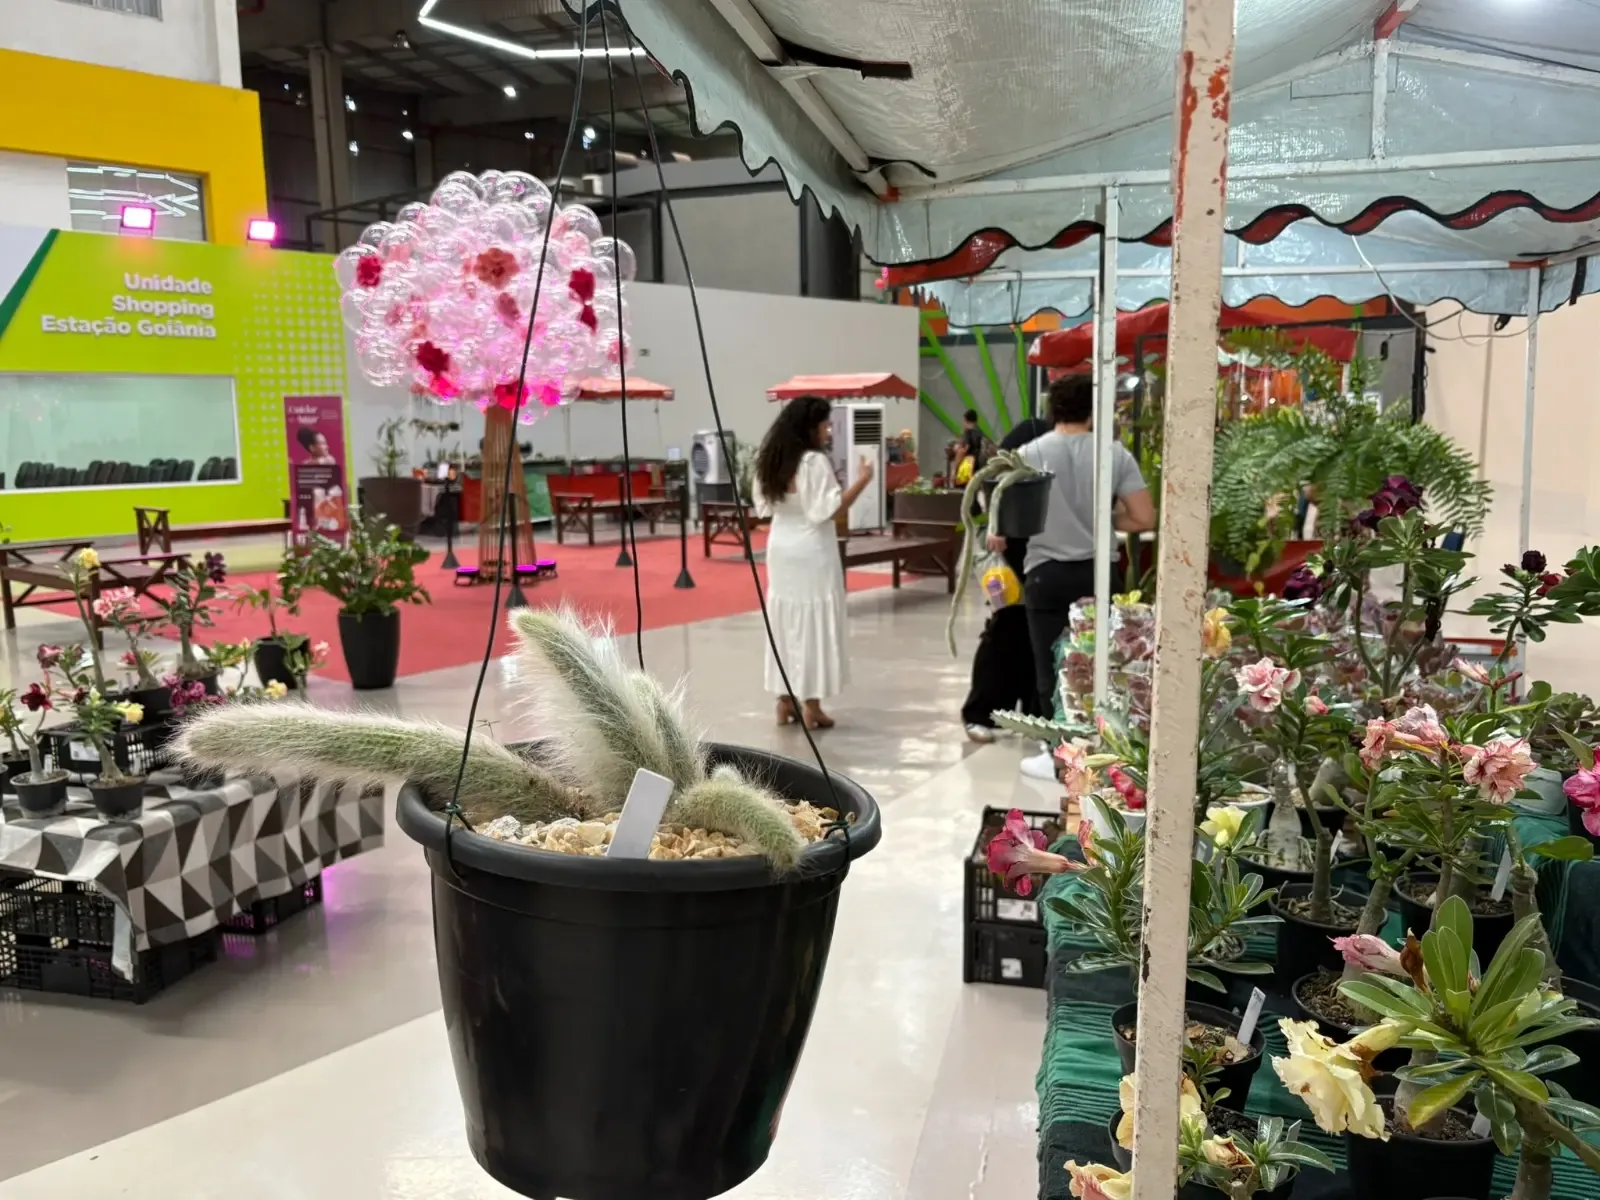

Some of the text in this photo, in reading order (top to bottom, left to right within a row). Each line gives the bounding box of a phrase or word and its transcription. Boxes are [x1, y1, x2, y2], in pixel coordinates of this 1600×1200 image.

[123, 272, 213, 294] Unidade
[112, 295, 215, 319] Shopping
[41, 314, 216, 338] Estação Goiânia
